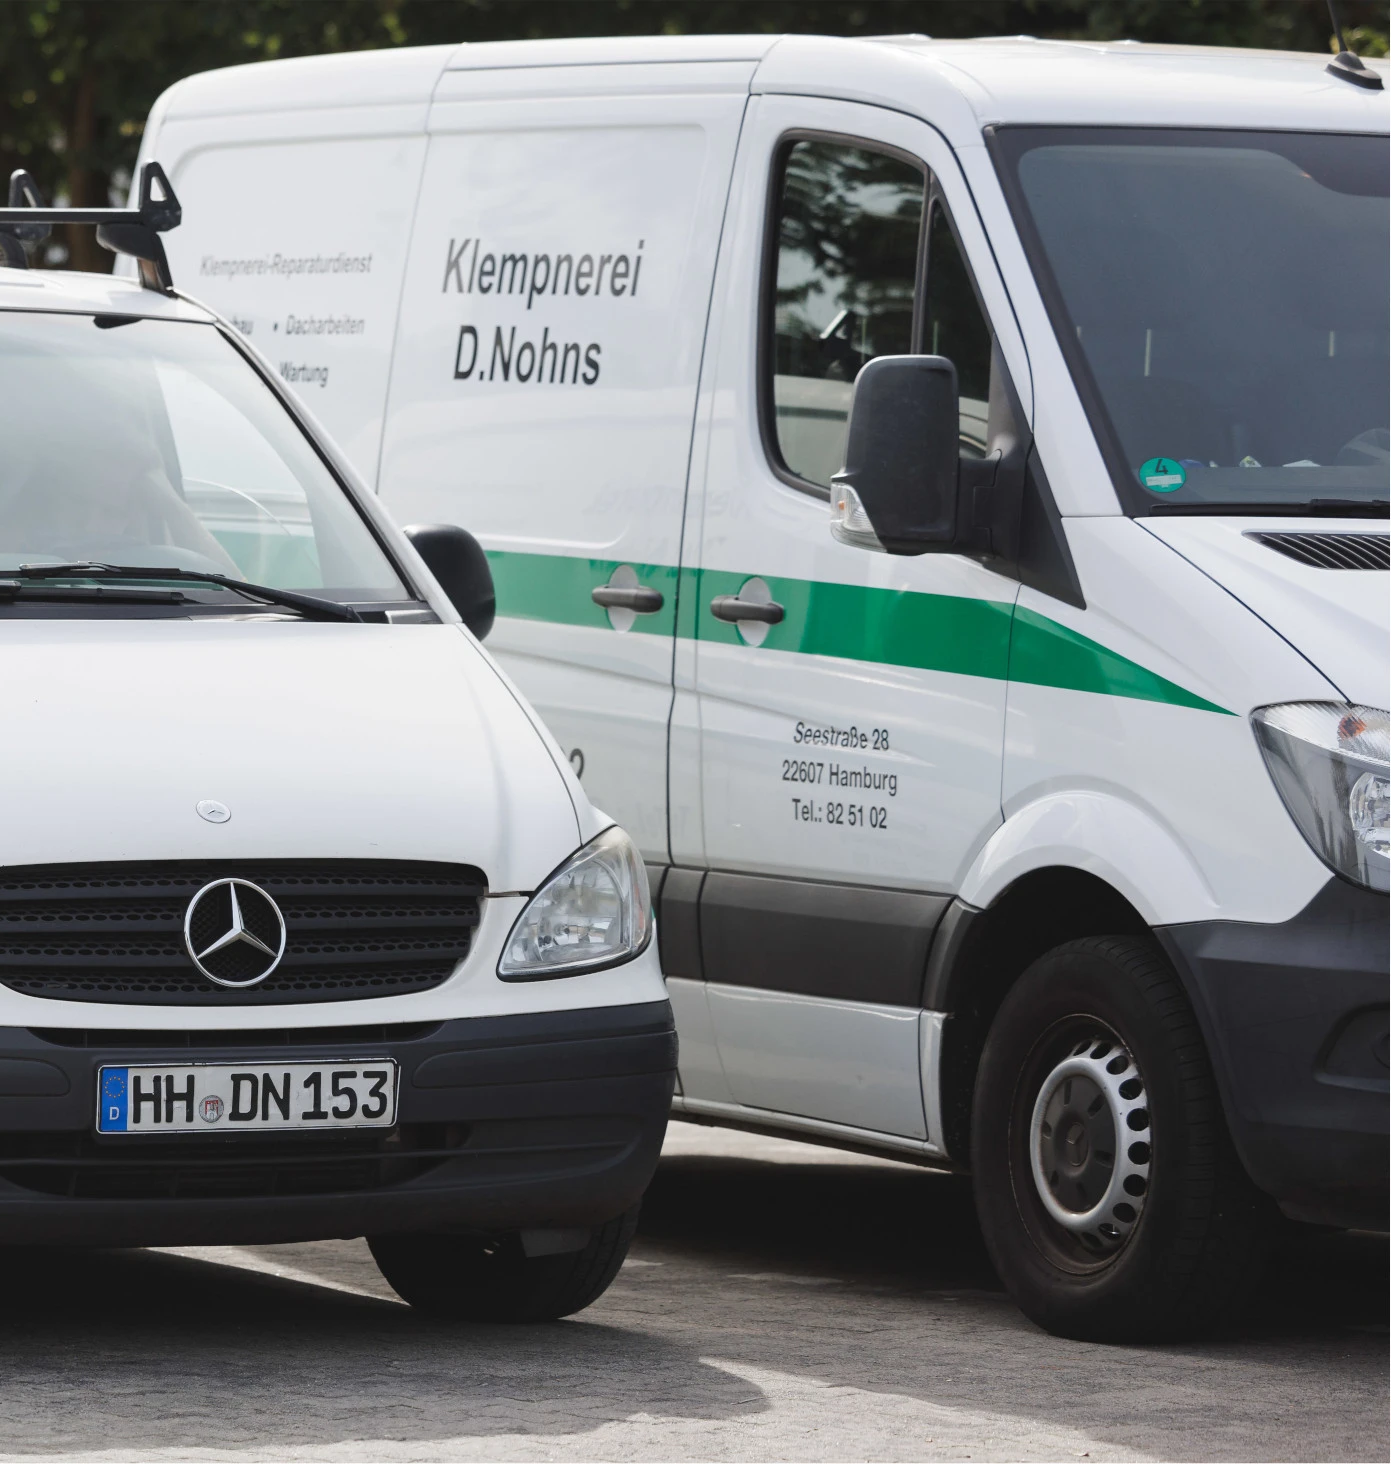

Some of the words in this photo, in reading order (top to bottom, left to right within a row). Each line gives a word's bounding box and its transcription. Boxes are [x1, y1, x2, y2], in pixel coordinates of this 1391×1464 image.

[200, 252, 372, 281] Klempnerei-Reparaturdienst
[442, 238, 645, 309] Klempnerei
[285, 314, 365, 335] Dacharbeiten
[279, 361, 329, 388] Wartung
[1155, 459, 1168, 474] 4
[793, 722, 868, 749] Seestraße
[872, 728, 889, 751] 28
[781, 760, 824, 785] 22607
[828, 763, 898, 796] Hamburg
[792, 798, 823, 823] Tel.:
[826, 802, 844, 826] 82
[847, 803, 864, 828] 51
[868, 805, 887, 829] 02
[132, 1074, 195, 1124] HH
[228, 1072, 291, 1122] DN
[301, 1070, 388, 1120] 153
[109, 1106, 120, 1120] D
